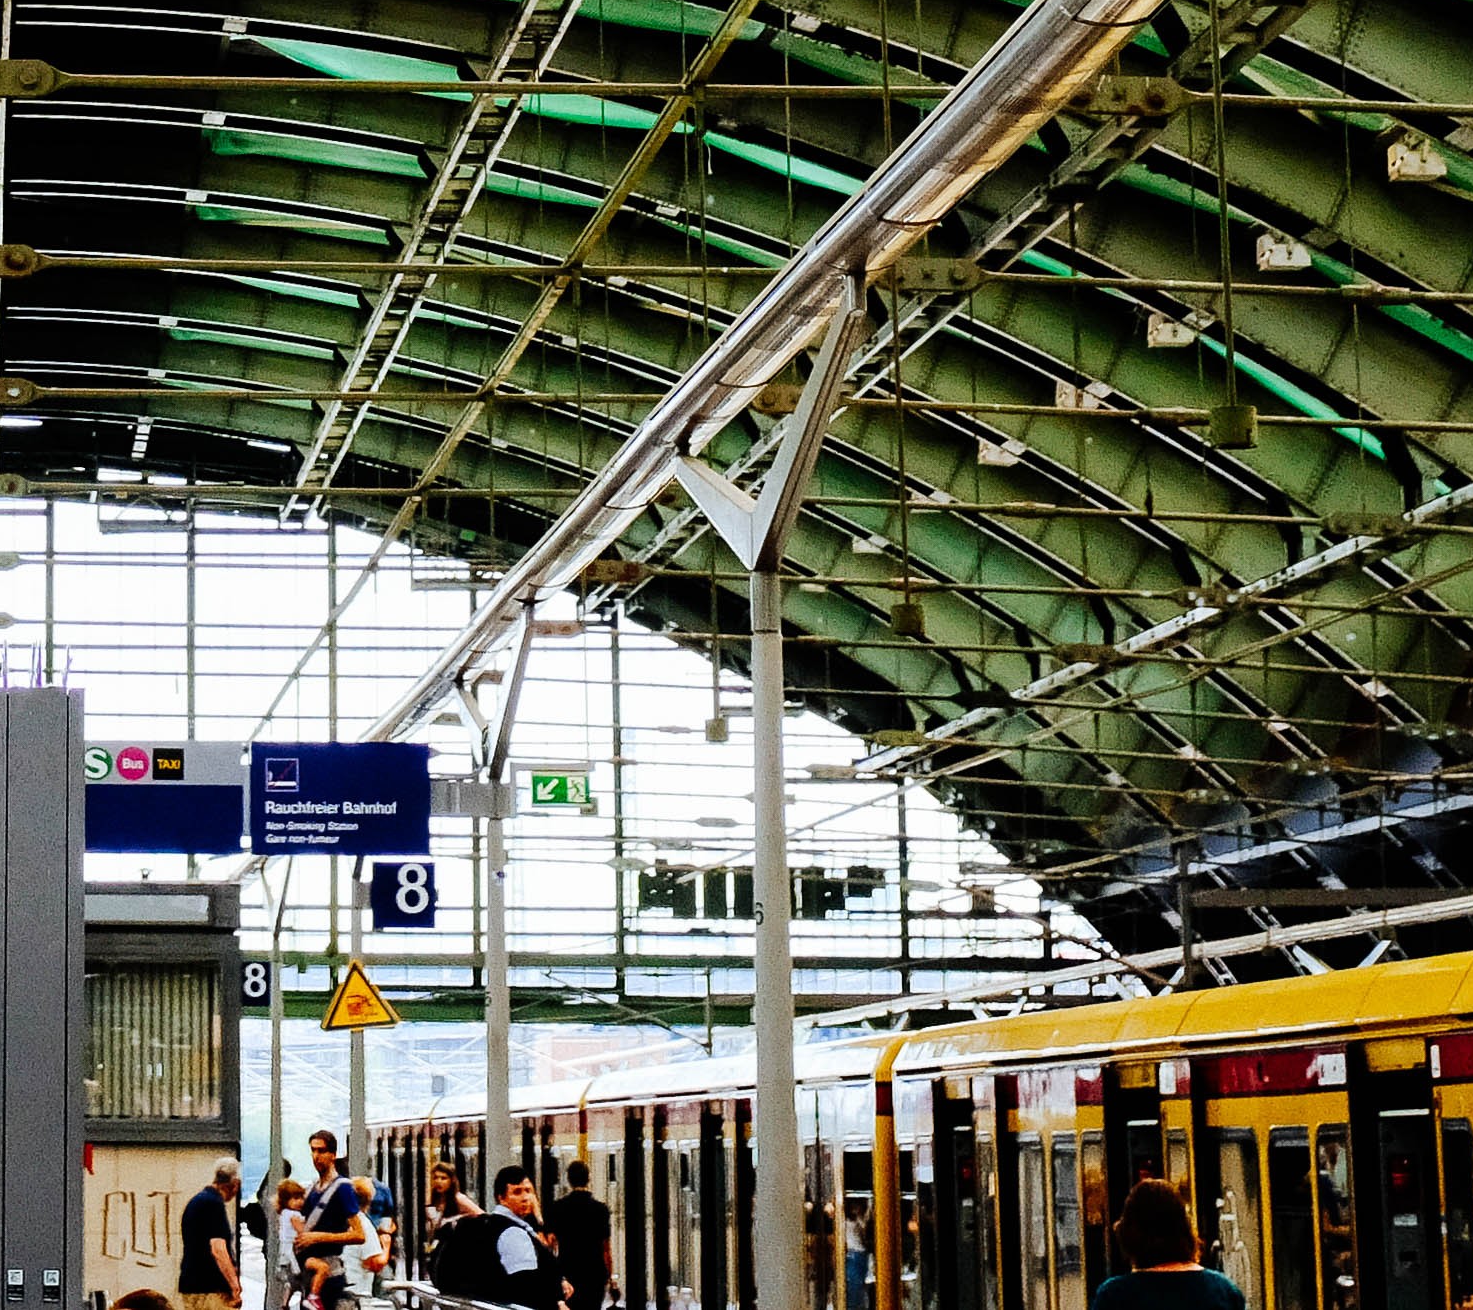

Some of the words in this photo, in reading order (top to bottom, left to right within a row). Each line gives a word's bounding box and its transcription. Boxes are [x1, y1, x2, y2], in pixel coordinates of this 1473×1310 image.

[84, 748, 110, 779] S
[121, 757, 145, 770] Bus
[156, 758, 182, 770] TAXI
[264, 800, 340, 815] Rauchfreier
[343, 800, 398, 815] Bahnhof
[395, 863, 430, 915] 8
[242, 962, 268, 998] 8
